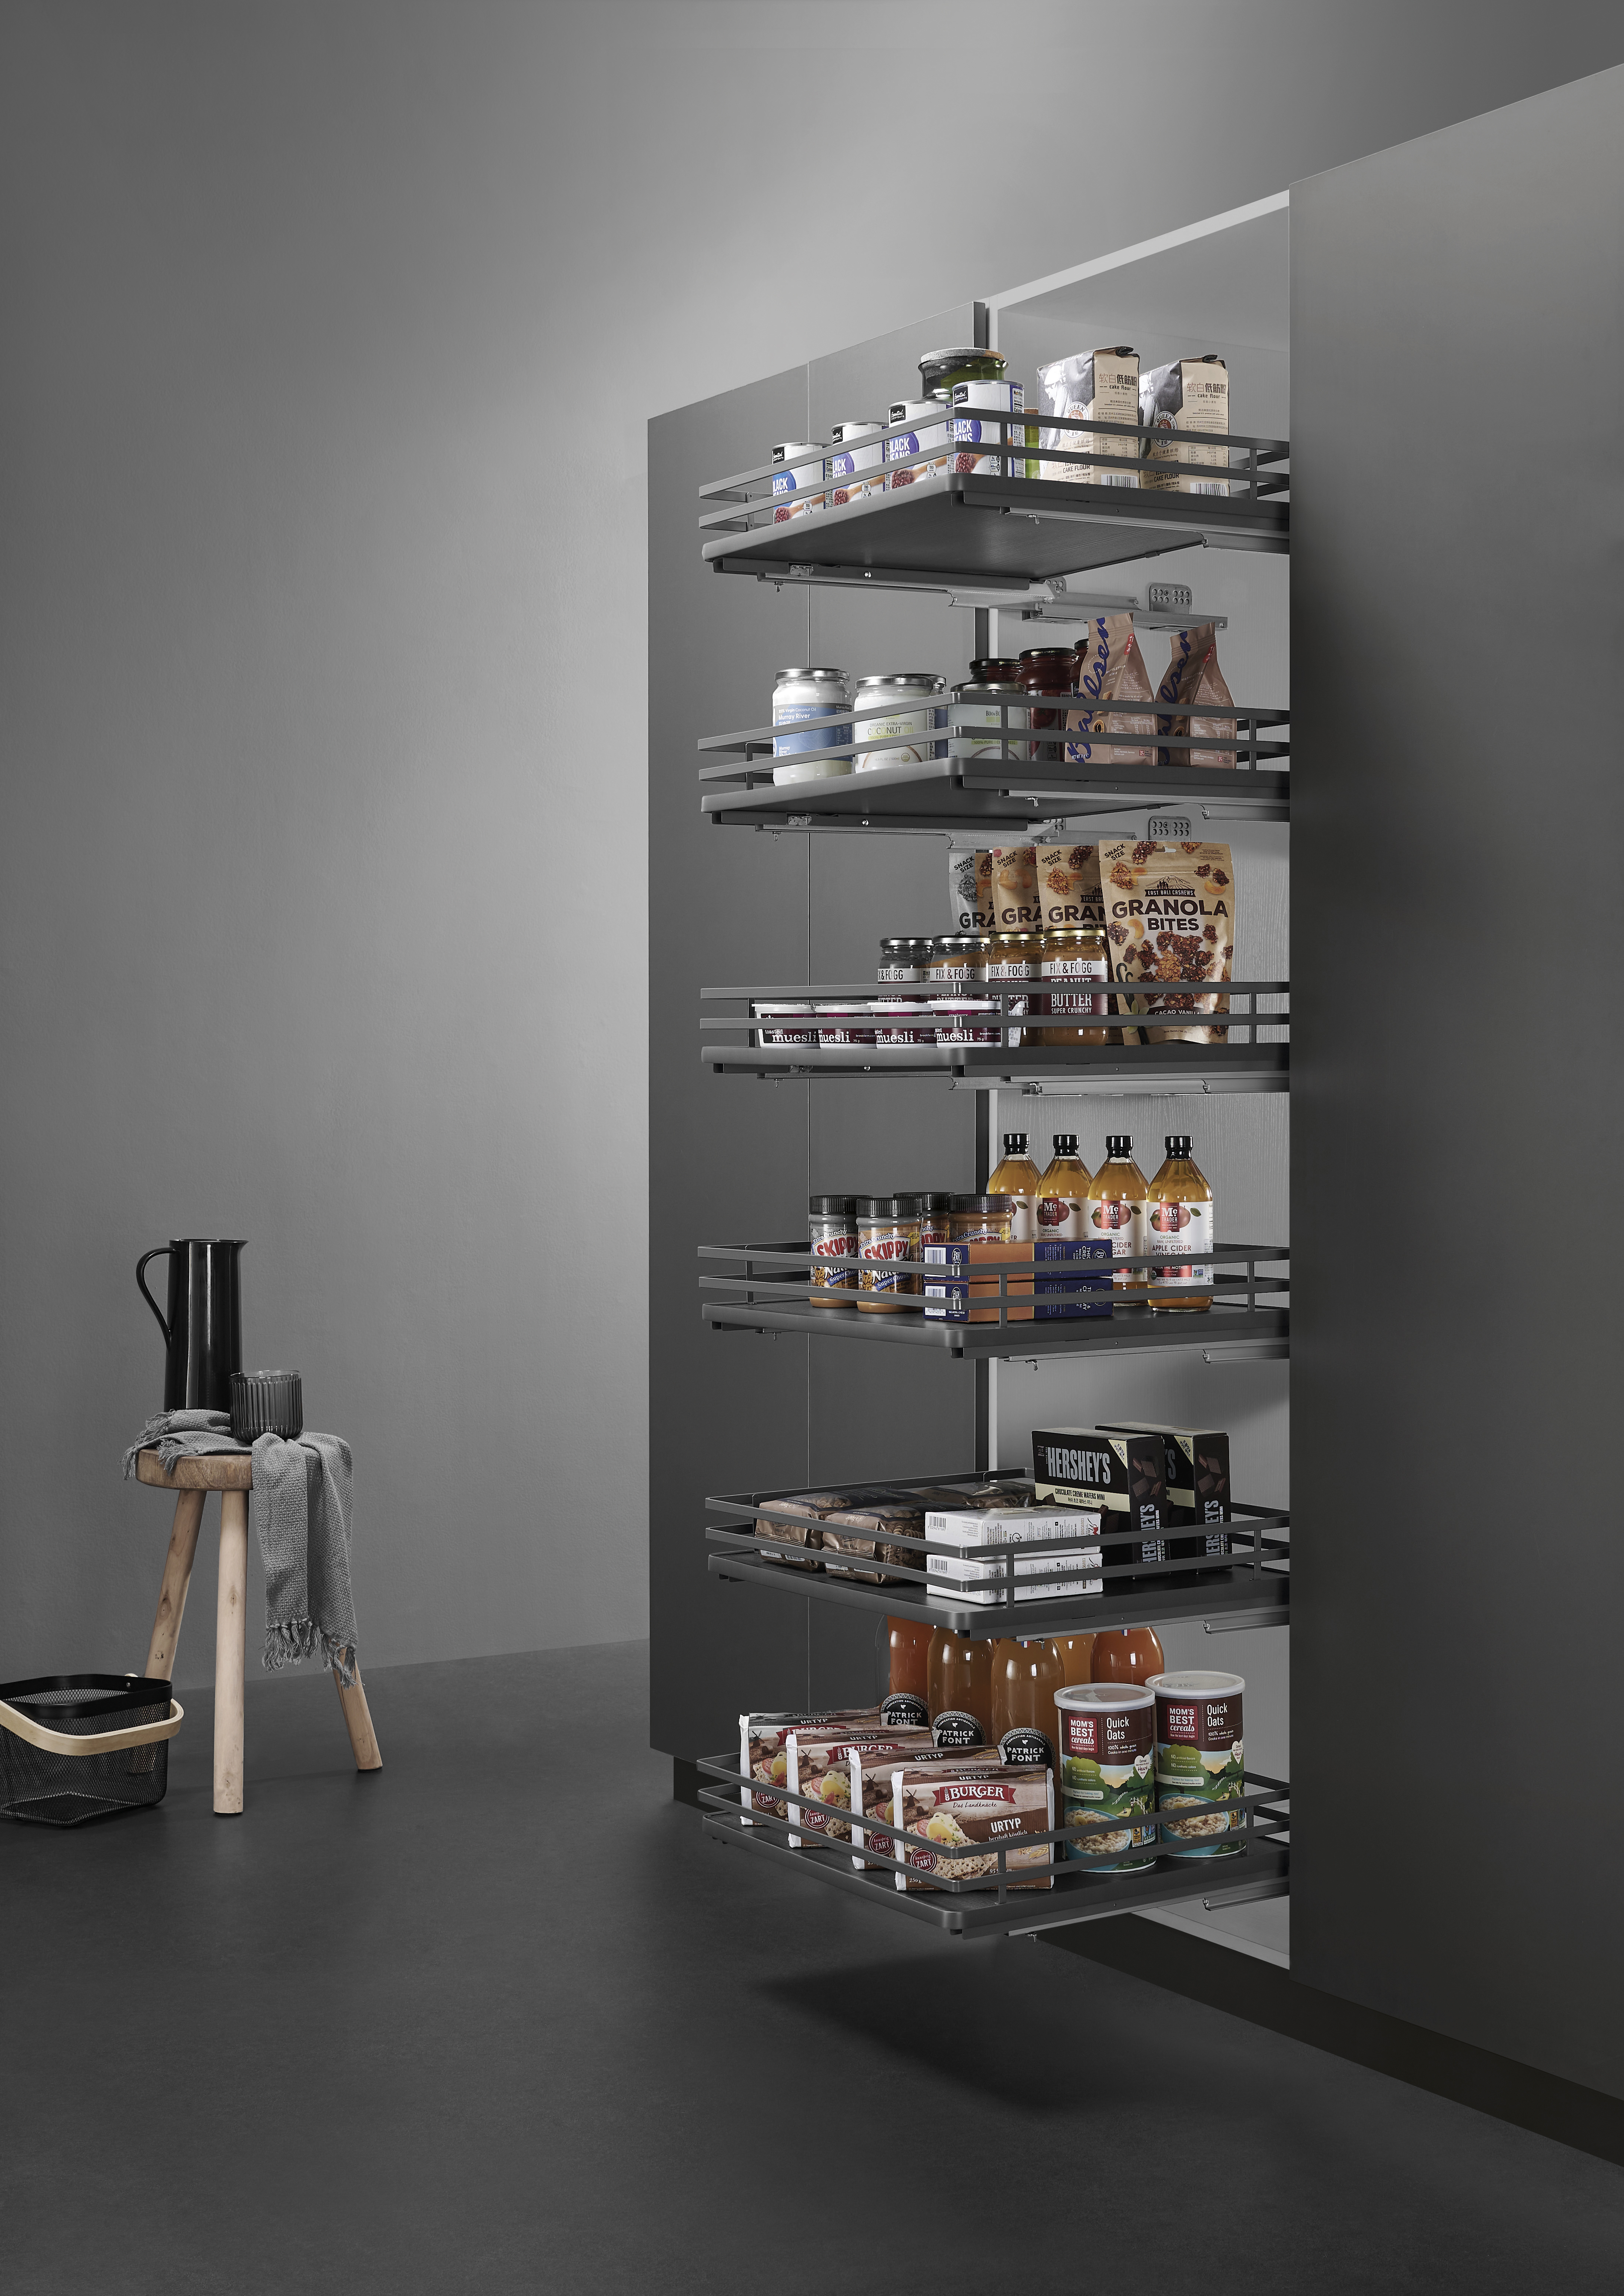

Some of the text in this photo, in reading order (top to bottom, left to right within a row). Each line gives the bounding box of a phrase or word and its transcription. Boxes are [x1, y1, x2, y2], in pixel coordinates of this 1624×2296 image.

[1099, 373, 1137, 386] 软白低筋粉
[1187, 382, 1226, 394] 软白低筋粉
[1067, 405, 1085, 413] QUEEN
[1156, 414, 1172, 423] QUEEN
[954, 420, 972, 437] BLACK
[890, 437, 910, 453] BLACK
[867, 727, 901, 735] COCONUT
[1041, 849, 1063, 864] SNACK
[1104, 843, 1126, 858] SNACK
[1111, 850, 1125, 861] SIZE
[953, 856, 975, 871] SNACK
[996, 851, 1018, 865] SNACK
[1003, 857, 1017, 868] SIZE
[1047, 856, 1062, 866] SIZE
[960, 862, 974, 873] SIZE
[1048, 905, 1106, 923] GRAN
[1112, 899, 1228, 919] GRANOLA
[1147, 918, 1199, 931] BITES
[936, 968, 975, 979] FIX & FOGG
[991, 965, 1029, 977] FIX & FOGG
[1050, 962, 1092, 974] FIX & FOGG
[881, 970, 903, 980] & FOGG
[1051, 994, 1092, 1007] BUTTER
[772, 1031, 817, 1042] muesli
[819, 1031, 850, 1043] muesli
[876, 1031, 914, 1043] muesli
[937, 1029, 974, 1041] muesli
[813, 1229, 847, 1244] Extra Crunchy
[860, 1233, 896, 1248] Extra Crunchy
[952, 1229, 988, 1243] Extra Crunchy
[864, 1240, 908, 1260] SKIPPY
[877, 1277, 893, 1288] Super
[893, 1273, 910, 1282] Chunk
[1047, 1447, 1111, 1484] HERSHEY'S
[1207, 1703, 1228, 1716] Quick
[1070, 1719, 1093, 1727] MOM'S
[1107, 1716, 1129, 1729] Quick
[1170, 1715, 1194, 1724] BEST
[1208, 1716, 1224, 1727] Oats
[1071, 1727, 1093, 1737] BEST
[1107, 1730, 1125, 1740] Oats
[1006, 1735, 1046, 1746] FABRICATION ARTISANALE
[914, 1753, 943, 1761] URTYP
[949, 1786, 1005, 1799] BURGER
[810, 1815, 825, 1824] ZART
[990, 1818, 1021, 1833] URTYP
[988, 1833, 1008, 1841] herzhaft
[875, 1841, 890, 1851] ZART
[916, 1859, 932, 1868] ZART
